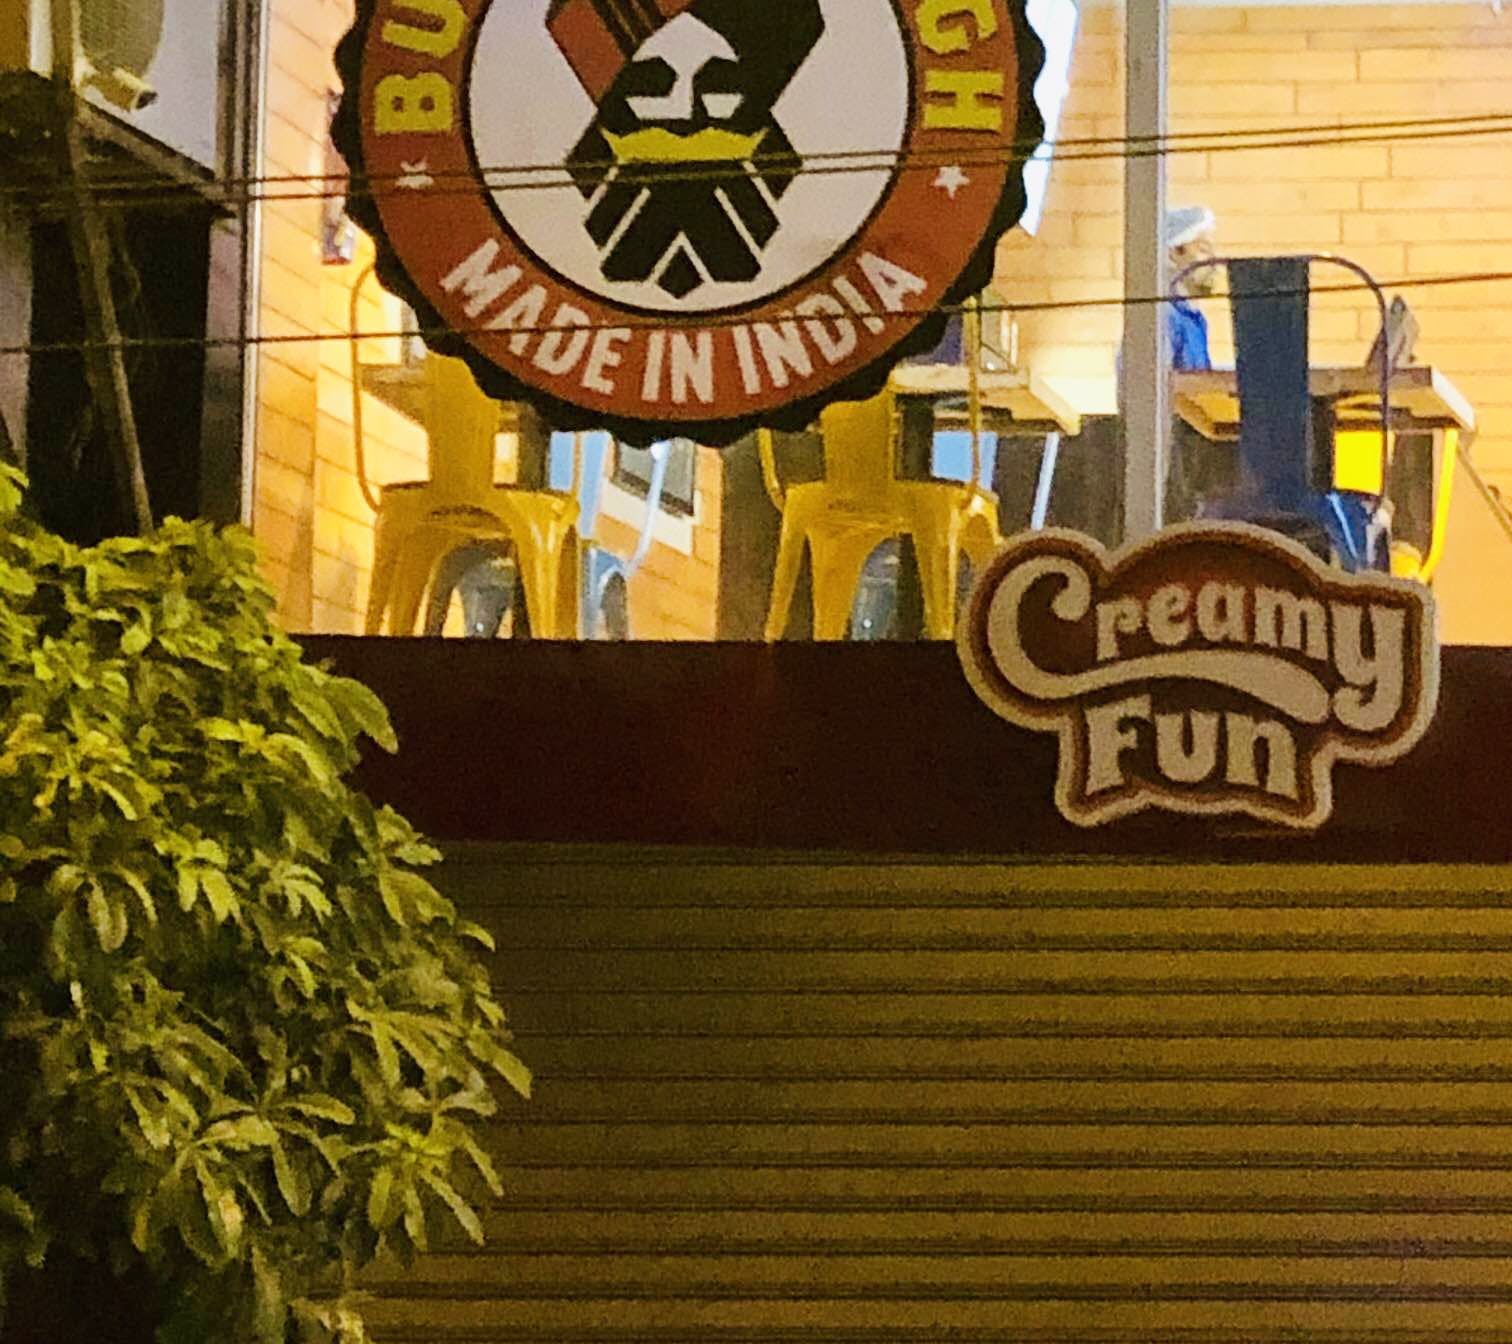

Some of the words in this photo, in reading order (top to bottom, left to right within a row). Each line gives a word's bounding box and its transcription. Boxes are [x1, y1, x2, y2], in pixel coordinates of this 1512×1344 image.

[439, 237, 631, 395] MADE
[641, 329, 714, 404] IN
[732, 250, 928, 395] INDIA
[987, 554, 1406, 732] Creamy
[1084, 693, 1298, 801] Fun
